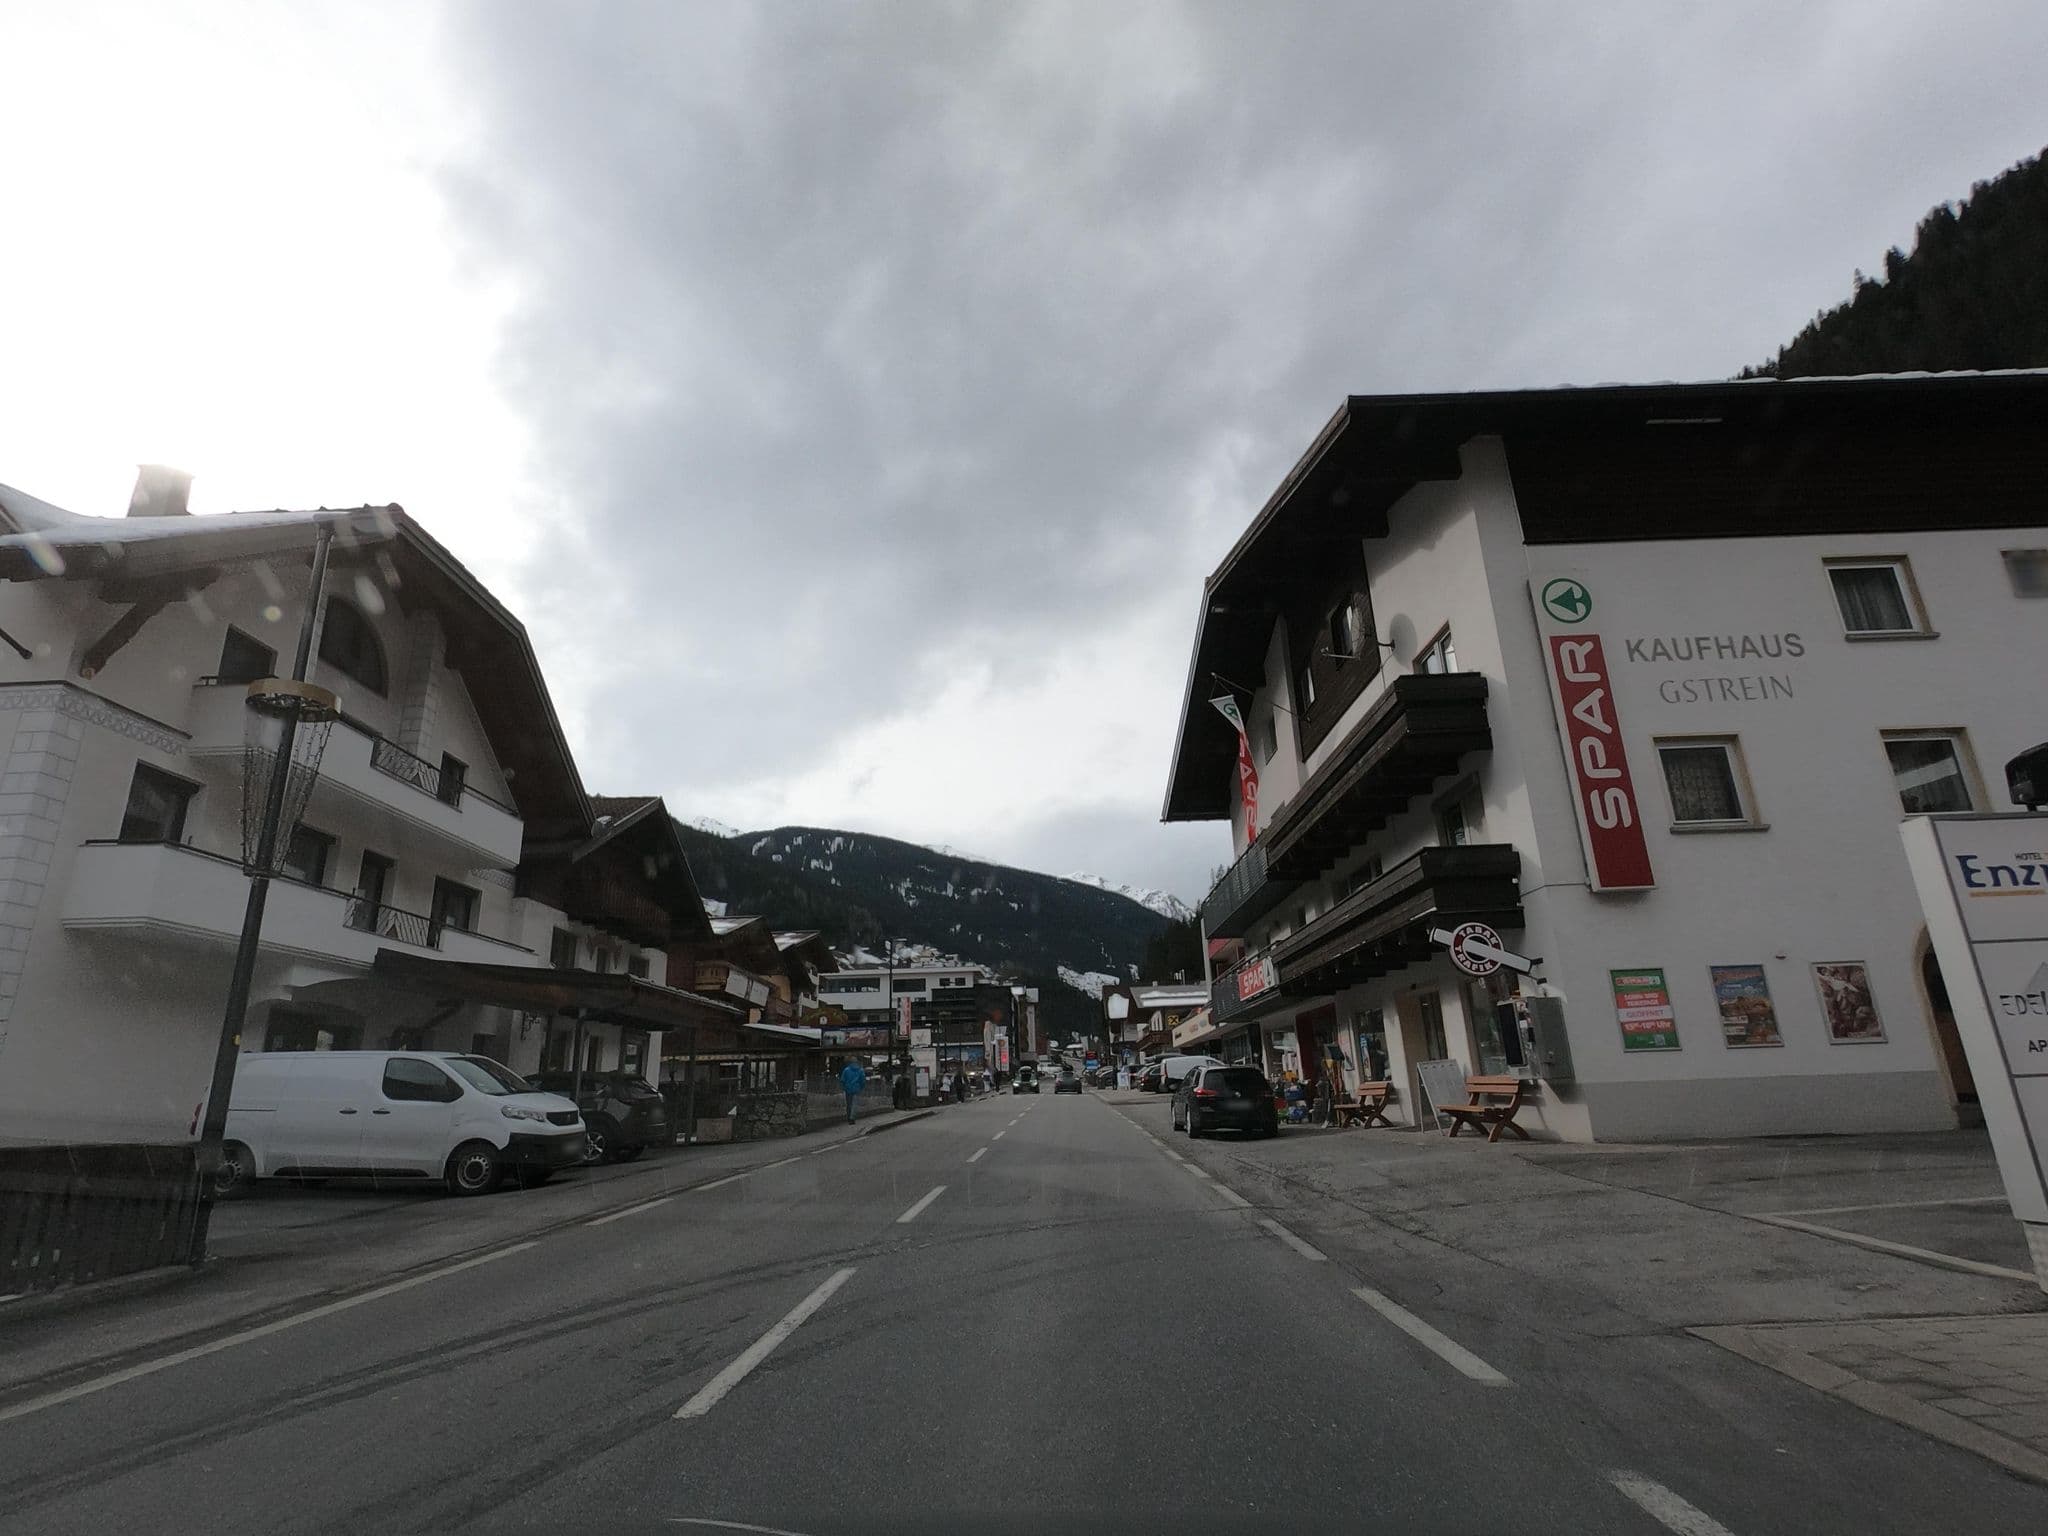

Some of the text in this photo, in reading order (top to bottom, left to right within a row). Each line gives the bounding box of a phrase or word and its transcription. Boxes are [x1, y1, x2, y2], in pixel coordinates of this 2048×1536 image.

[1625, 633, 1805, 663] KAUFHAUS
[1659, 675, 1795, 705] GSTREIN
[1560, 640, 1632, 829] SPAR
[2015, 852, 2043, 861] HOTEL
[1459, 926, 1500, 945] TABAK
[1454, 945, 1494, 972] TRAFIK
[1243, 965, 1265, 994] SPAR
